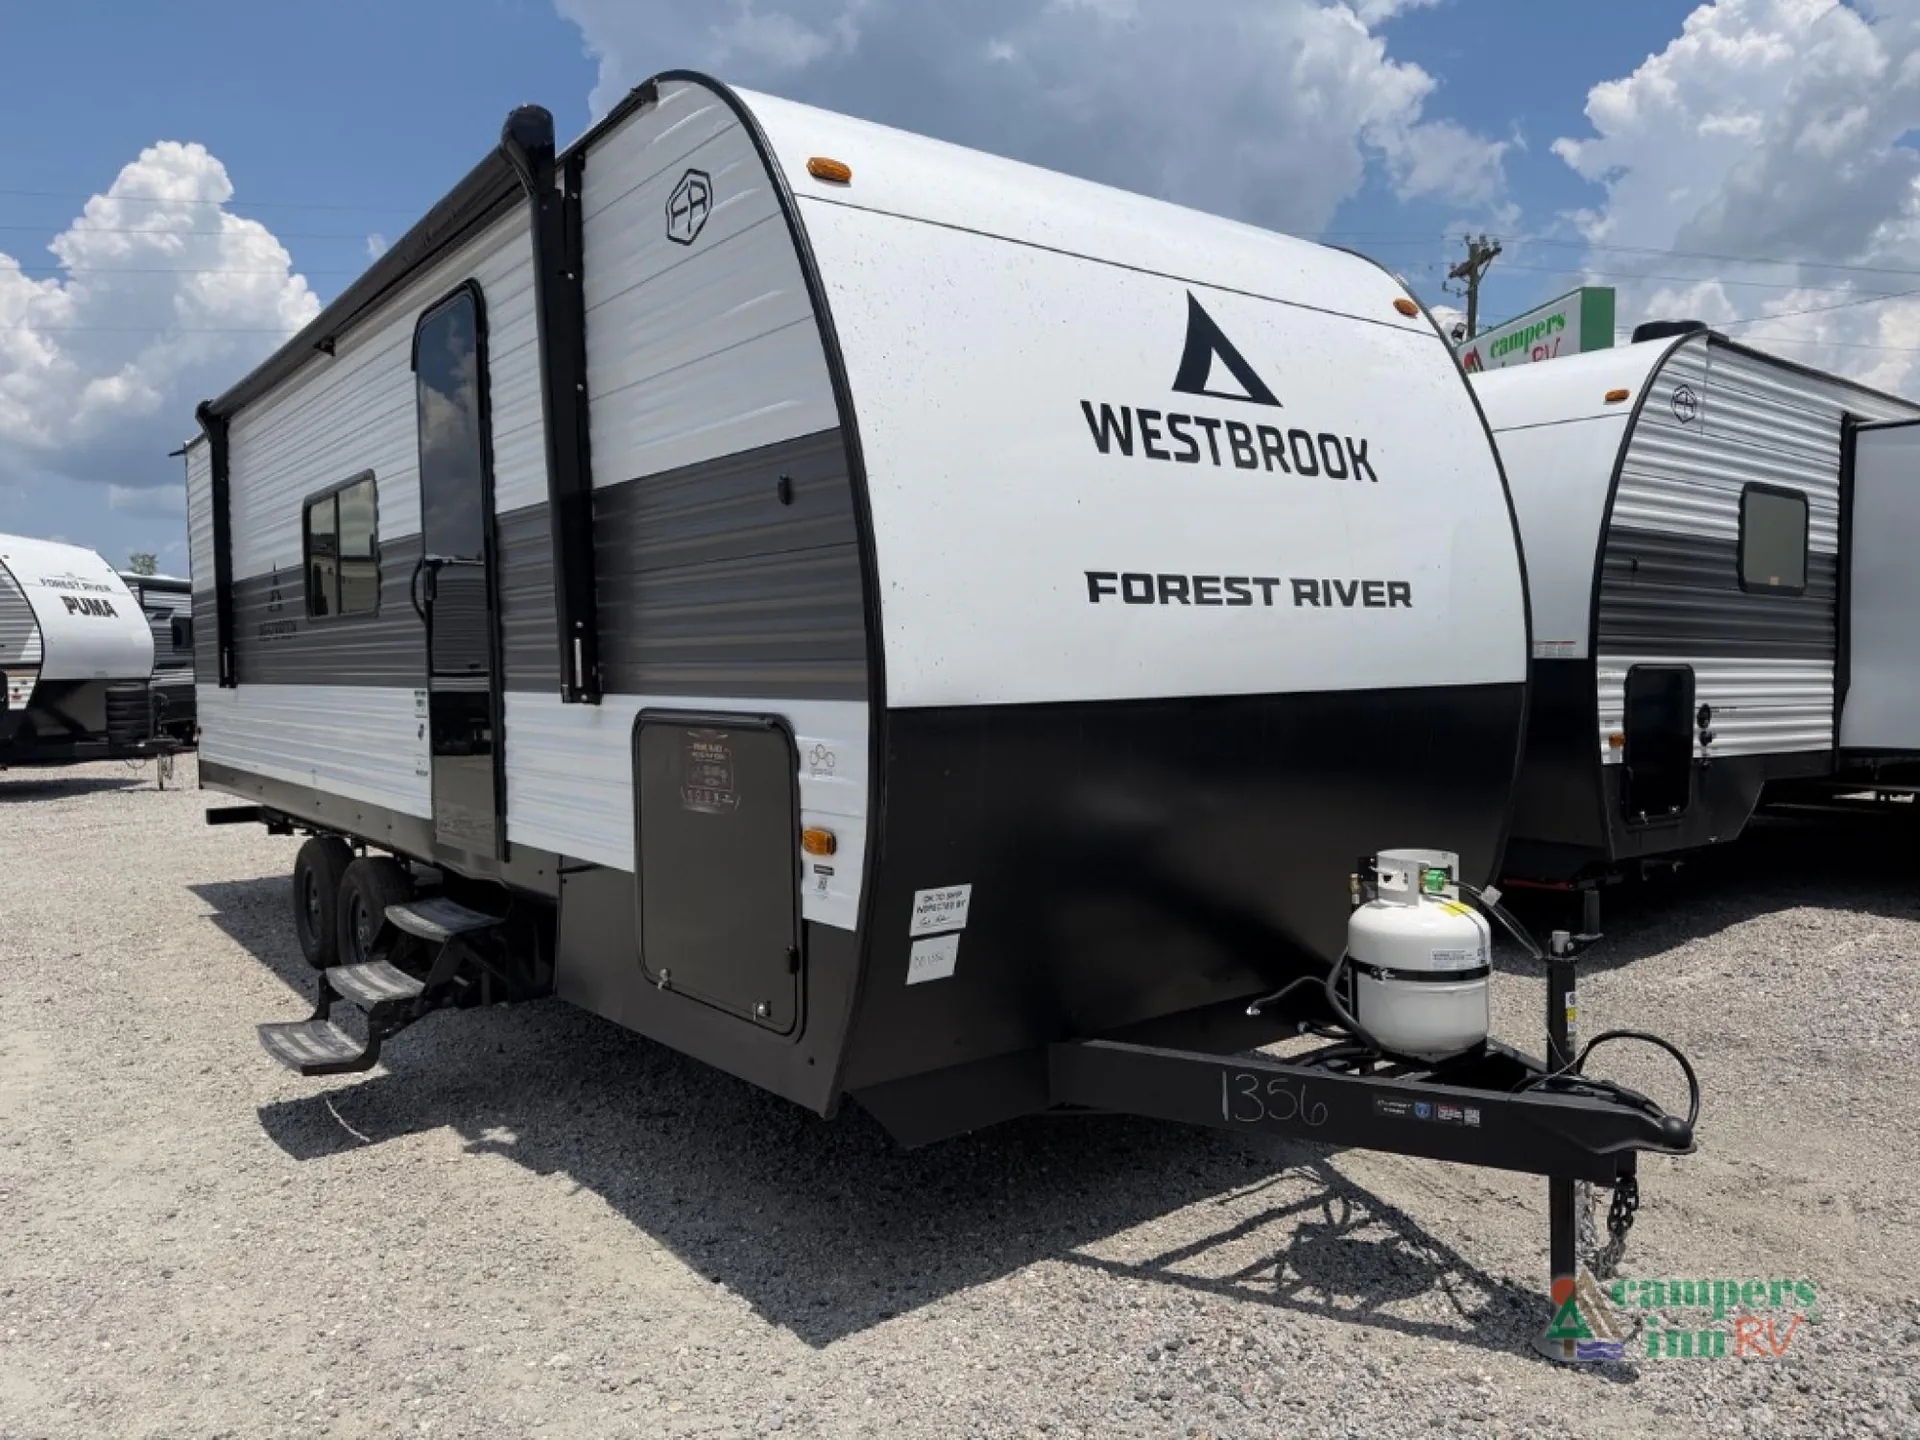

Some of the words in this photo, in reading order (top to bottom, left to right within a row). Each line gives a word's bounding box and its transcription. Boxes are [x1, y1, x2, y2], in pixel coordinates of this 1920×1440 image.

[1490, 311, 1566, 360] campers
[1532, 336, 1561, 362] RV
[1080, 399, 1379, 483] WESTBROOK
[60, 596, 118, 618] PUMA
[1084, 571, 1280, 606] FOREST
[1290, 577, 1413, 608] RIVER
[1222, 1071, 1328, 1126] 1356
